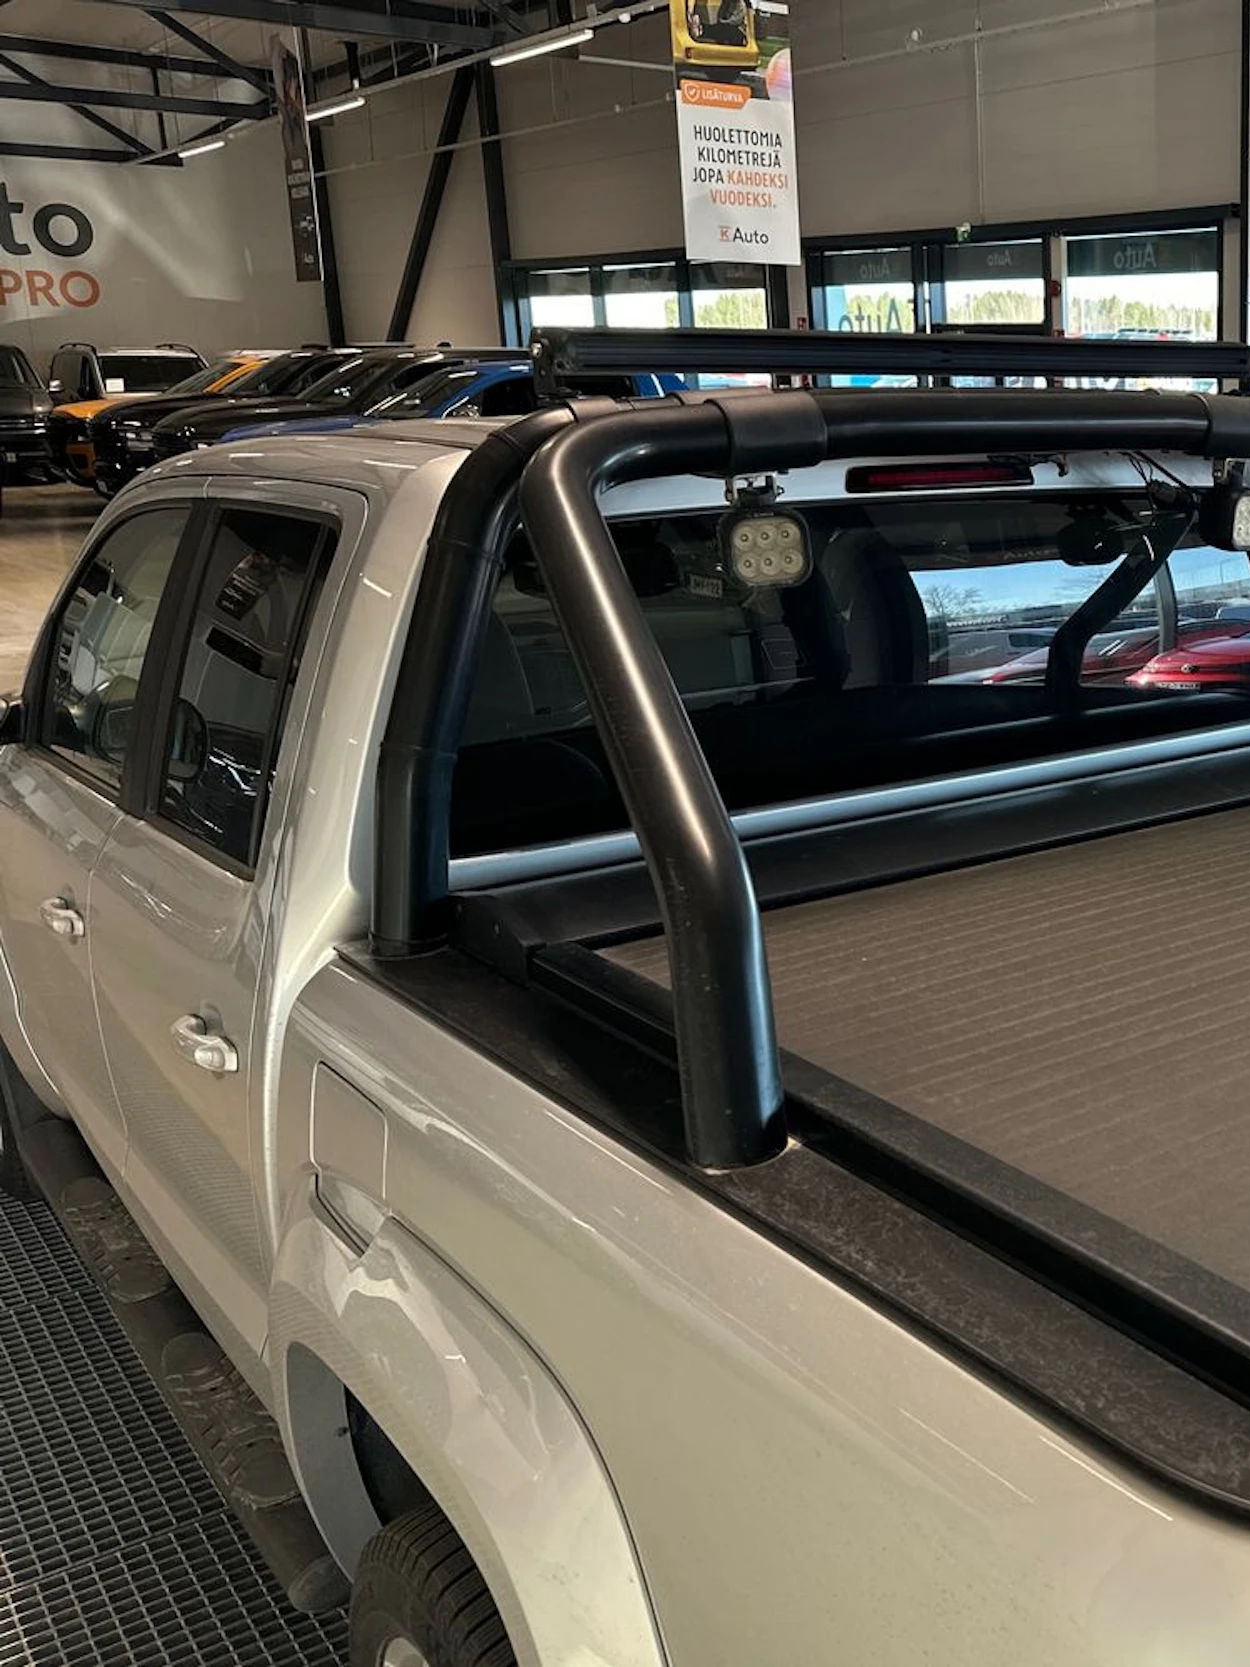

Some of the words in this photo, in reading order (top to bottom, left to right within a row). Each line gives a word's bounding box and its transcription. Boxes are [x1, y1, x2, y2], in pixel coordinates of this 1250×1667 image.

[693, 124, 783, 149] HUOLETTOMIA
[697, 146, 782, 169] KILOMETREJÄ
[692, 167, 725, 184] JOPA
[726, 169, 789, 190] KAHDEKSI
[709, 189, 777, 209] VUODEKSI.
[732, 227, 769, 245] Auto
[0, 268, 101, 308] PRO
